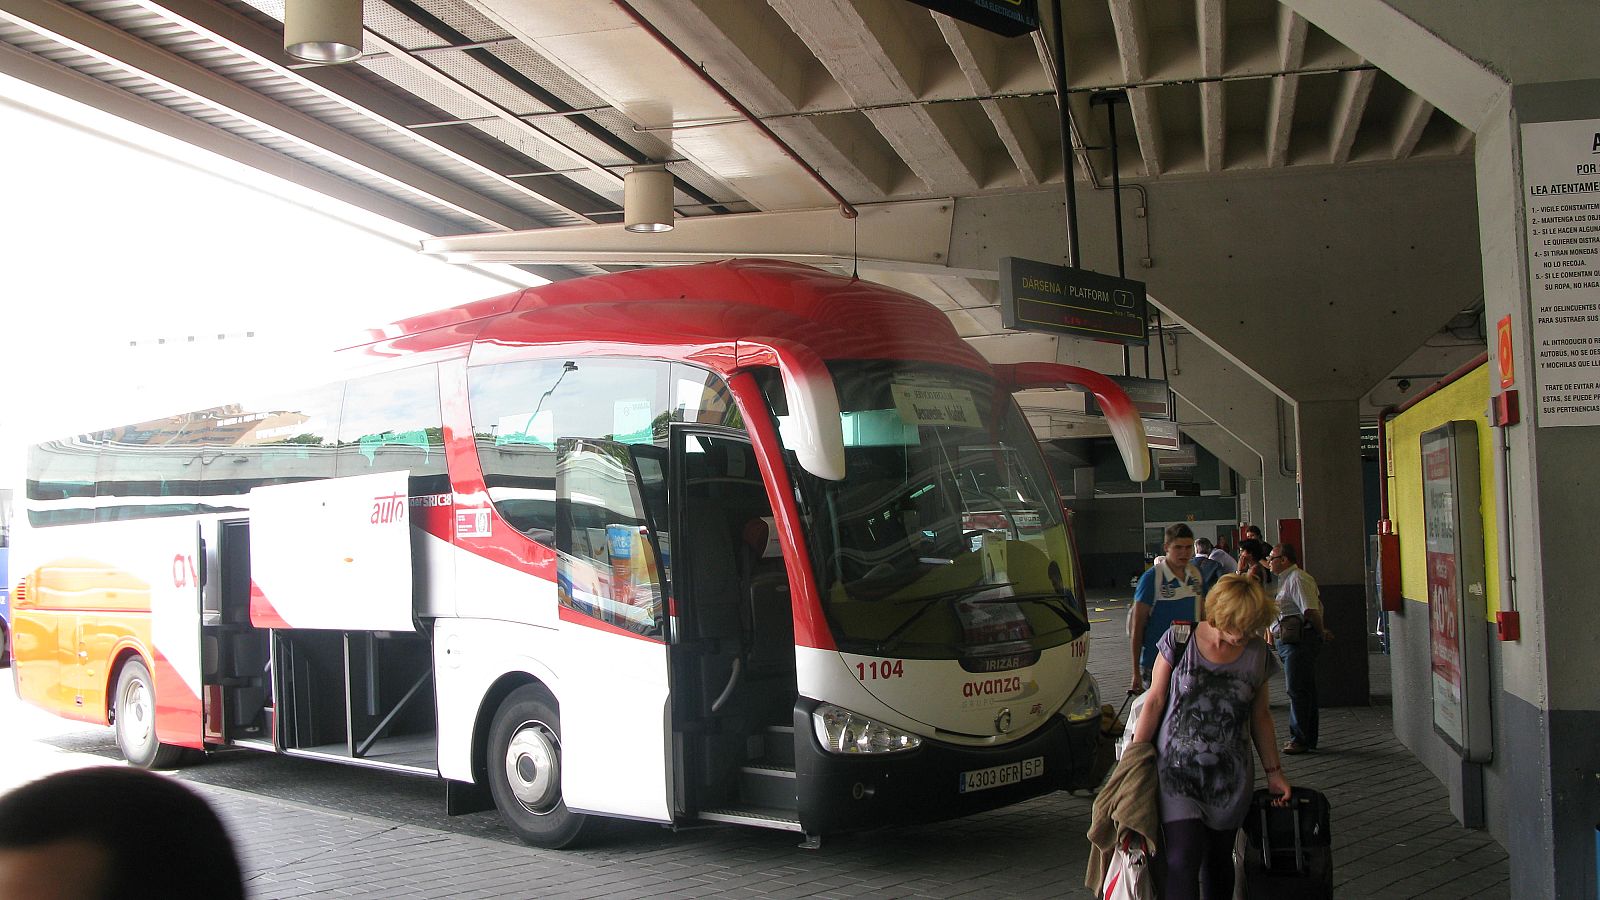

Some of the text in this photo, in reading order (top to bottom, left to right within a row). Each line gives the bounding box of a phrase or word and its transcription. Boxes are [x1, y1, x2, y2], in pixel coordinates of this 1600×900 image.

[1577, 164, 1597, 174] POR
[1531, 186, 1548, 195] LEA
[1560, 204, 1600, 212] CONSTANTEM
[1022, 276, 1062, 292] DÁRSENA
[1070, 286, 1110, 302] PLATFORM
[1122, 294, 1126, 304] 7
[1071, 641, 1086, 658] 1104
[856, 660, 904, 680] 1104
[986, 658, 1020, 671] IRIZAR
[962, 676, 1020, 698] avanza
[968, 770, 996, 788] 4303
[1000, 766, 1018, 783] GFR
